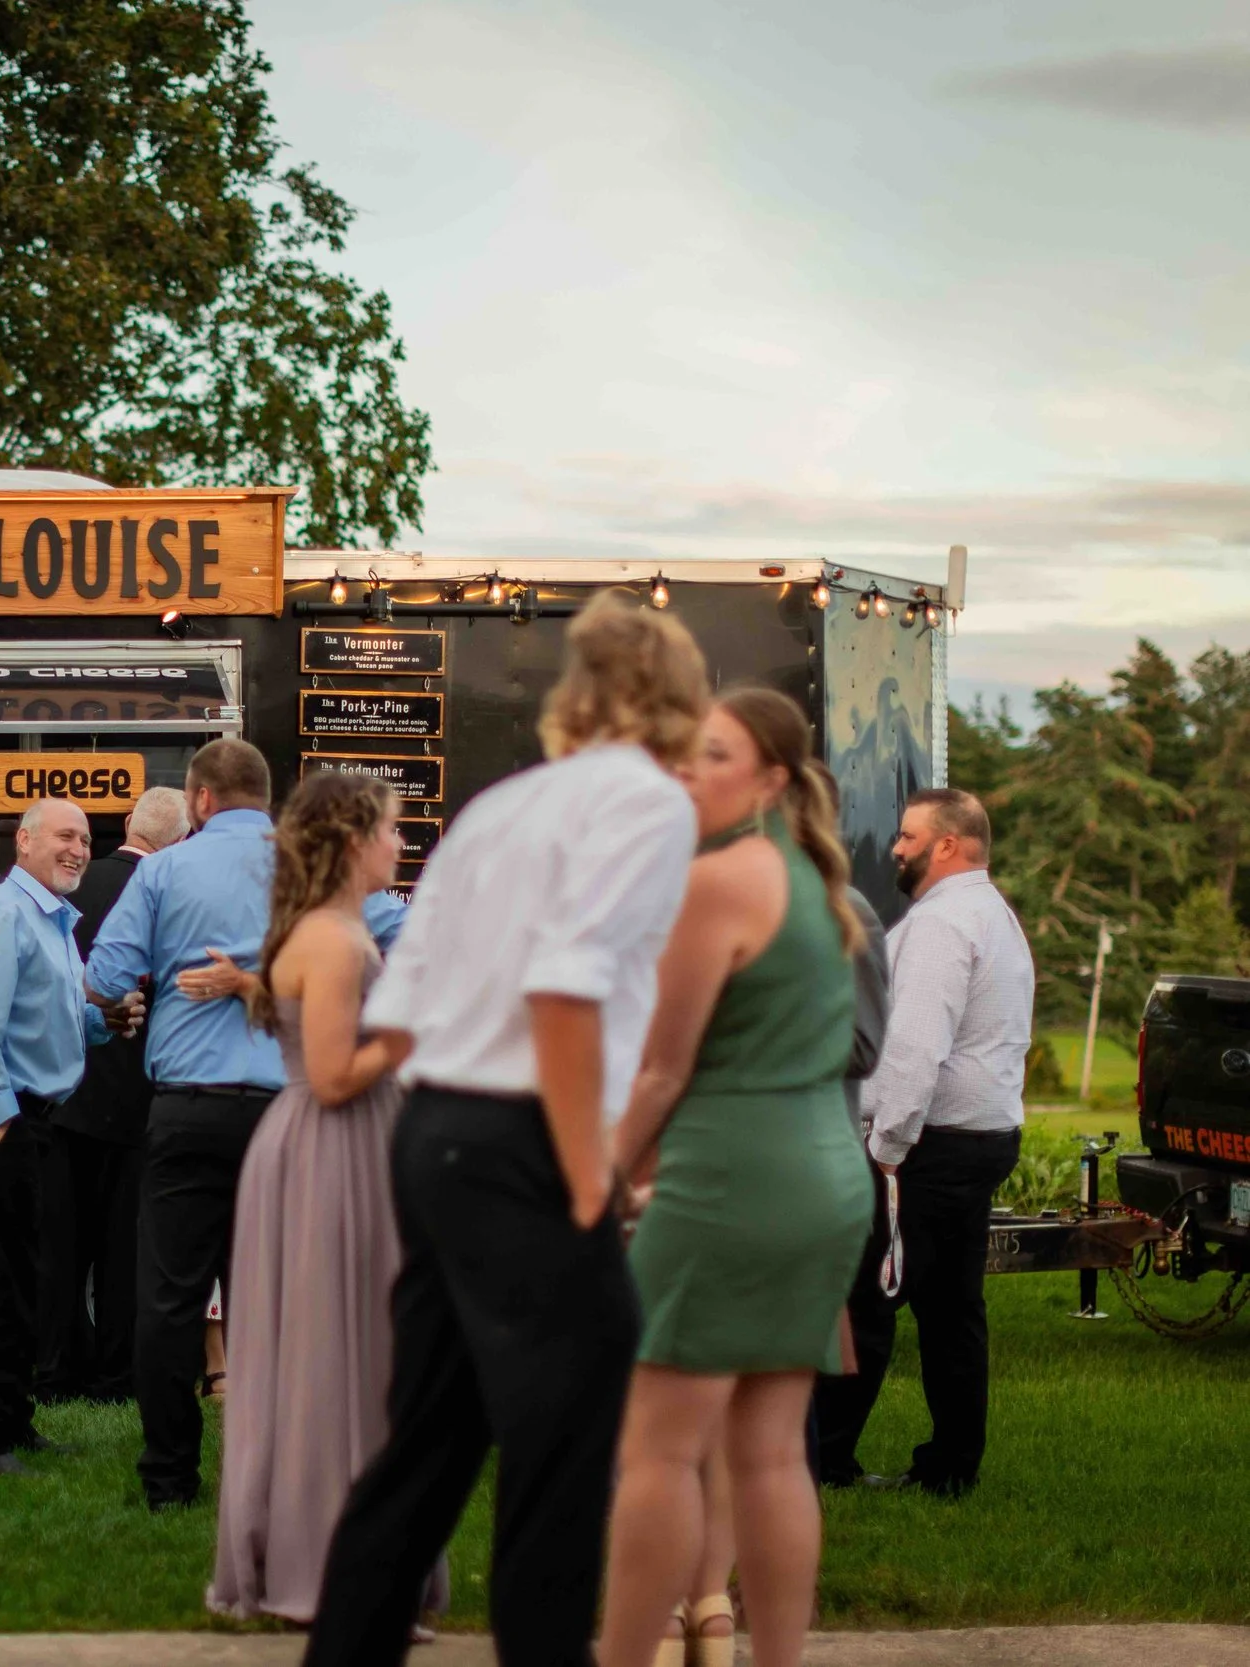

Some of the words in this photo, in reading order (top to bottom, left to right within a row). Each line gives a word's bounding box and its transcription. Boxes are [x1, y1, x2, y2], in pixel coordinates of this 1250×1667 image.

[324, 636, 338, 644] The
[343, 636, 404, 650] Vermonter
[321, 698, 335, 706] The
[341, 699, 409, 715] Pork-y-Pine
[340, 763, 404, 777] Godmother
[389, 889, 412, 905] Way
[1164, 1125, 1194, 1152] THE
